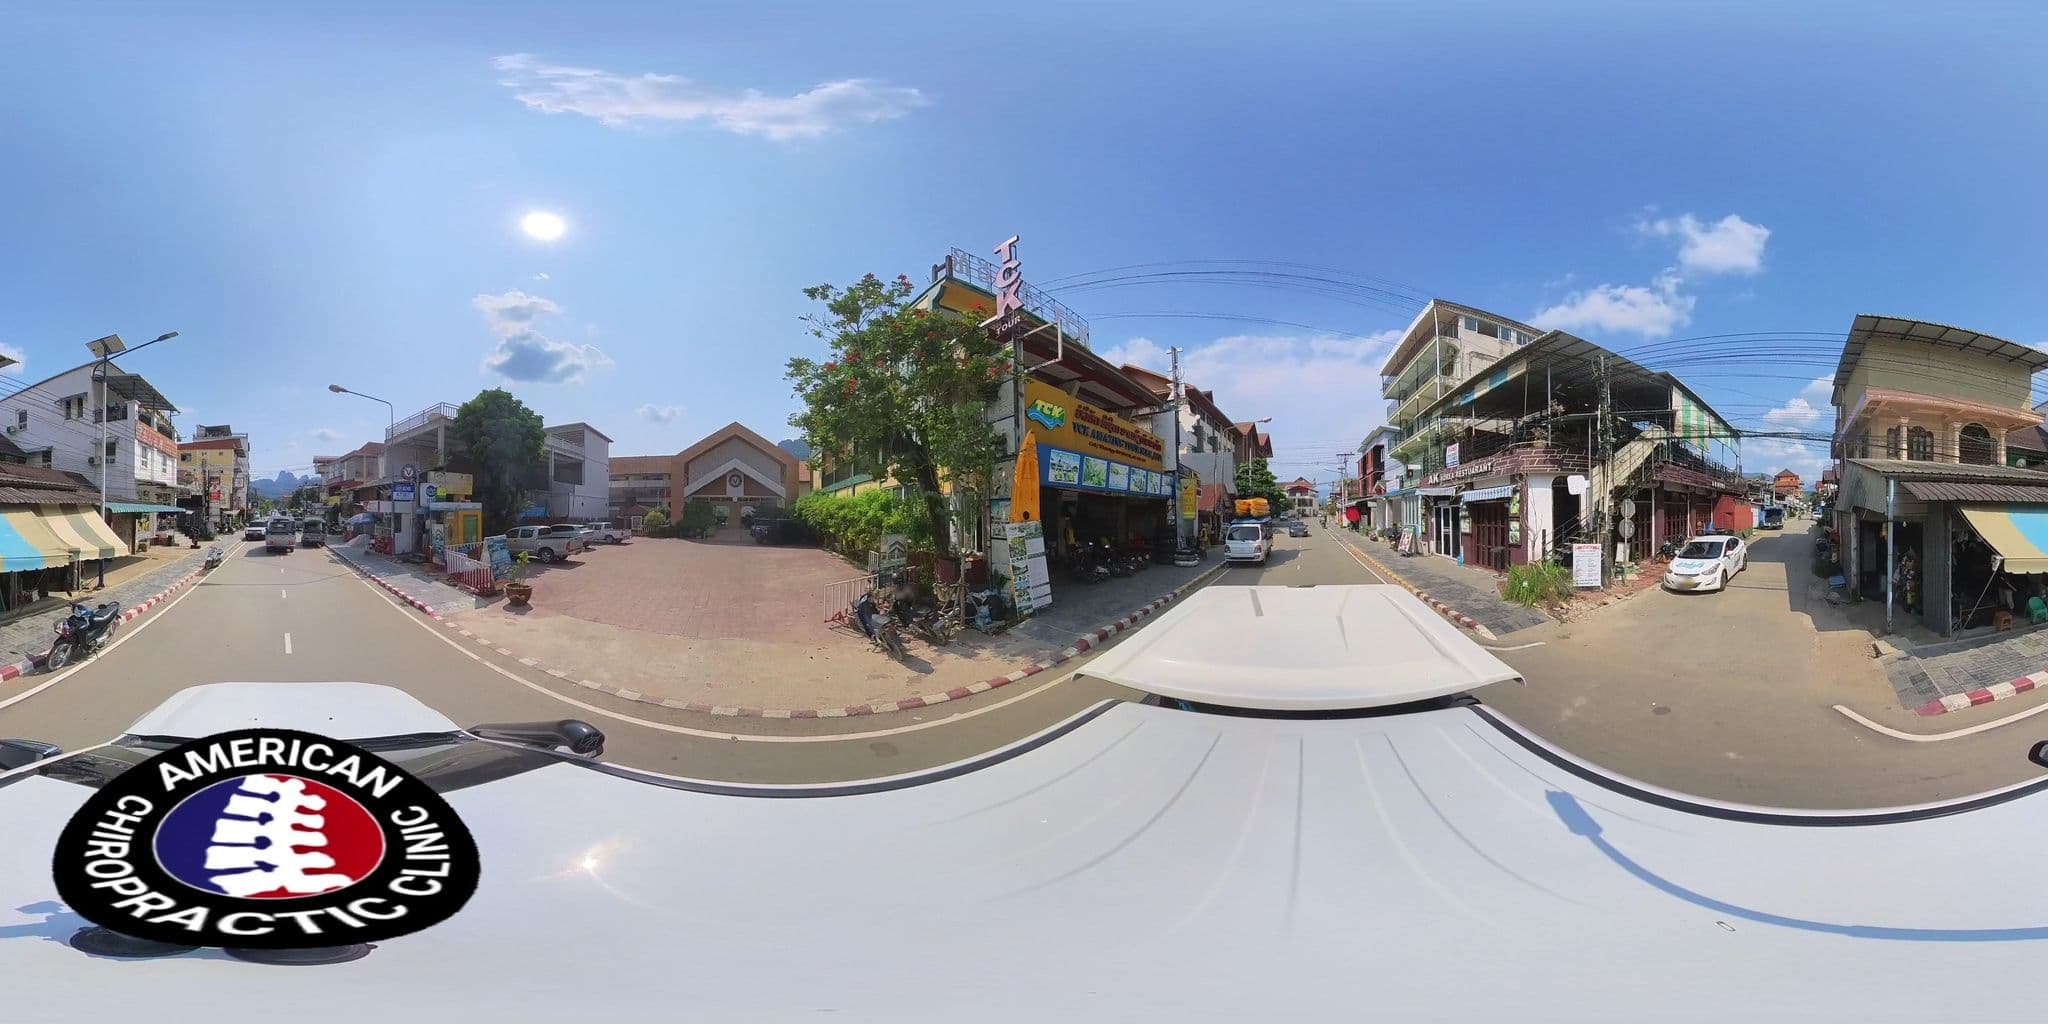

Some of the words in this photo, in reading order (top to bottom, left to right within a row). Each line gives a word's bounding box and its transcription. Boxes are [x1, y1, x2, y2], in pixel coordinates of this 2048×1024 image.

[993, 235, 1025, 320] TCK
[996, 315, 1021, 335] TOUR
[1428, 472, 1439, 484] AK
